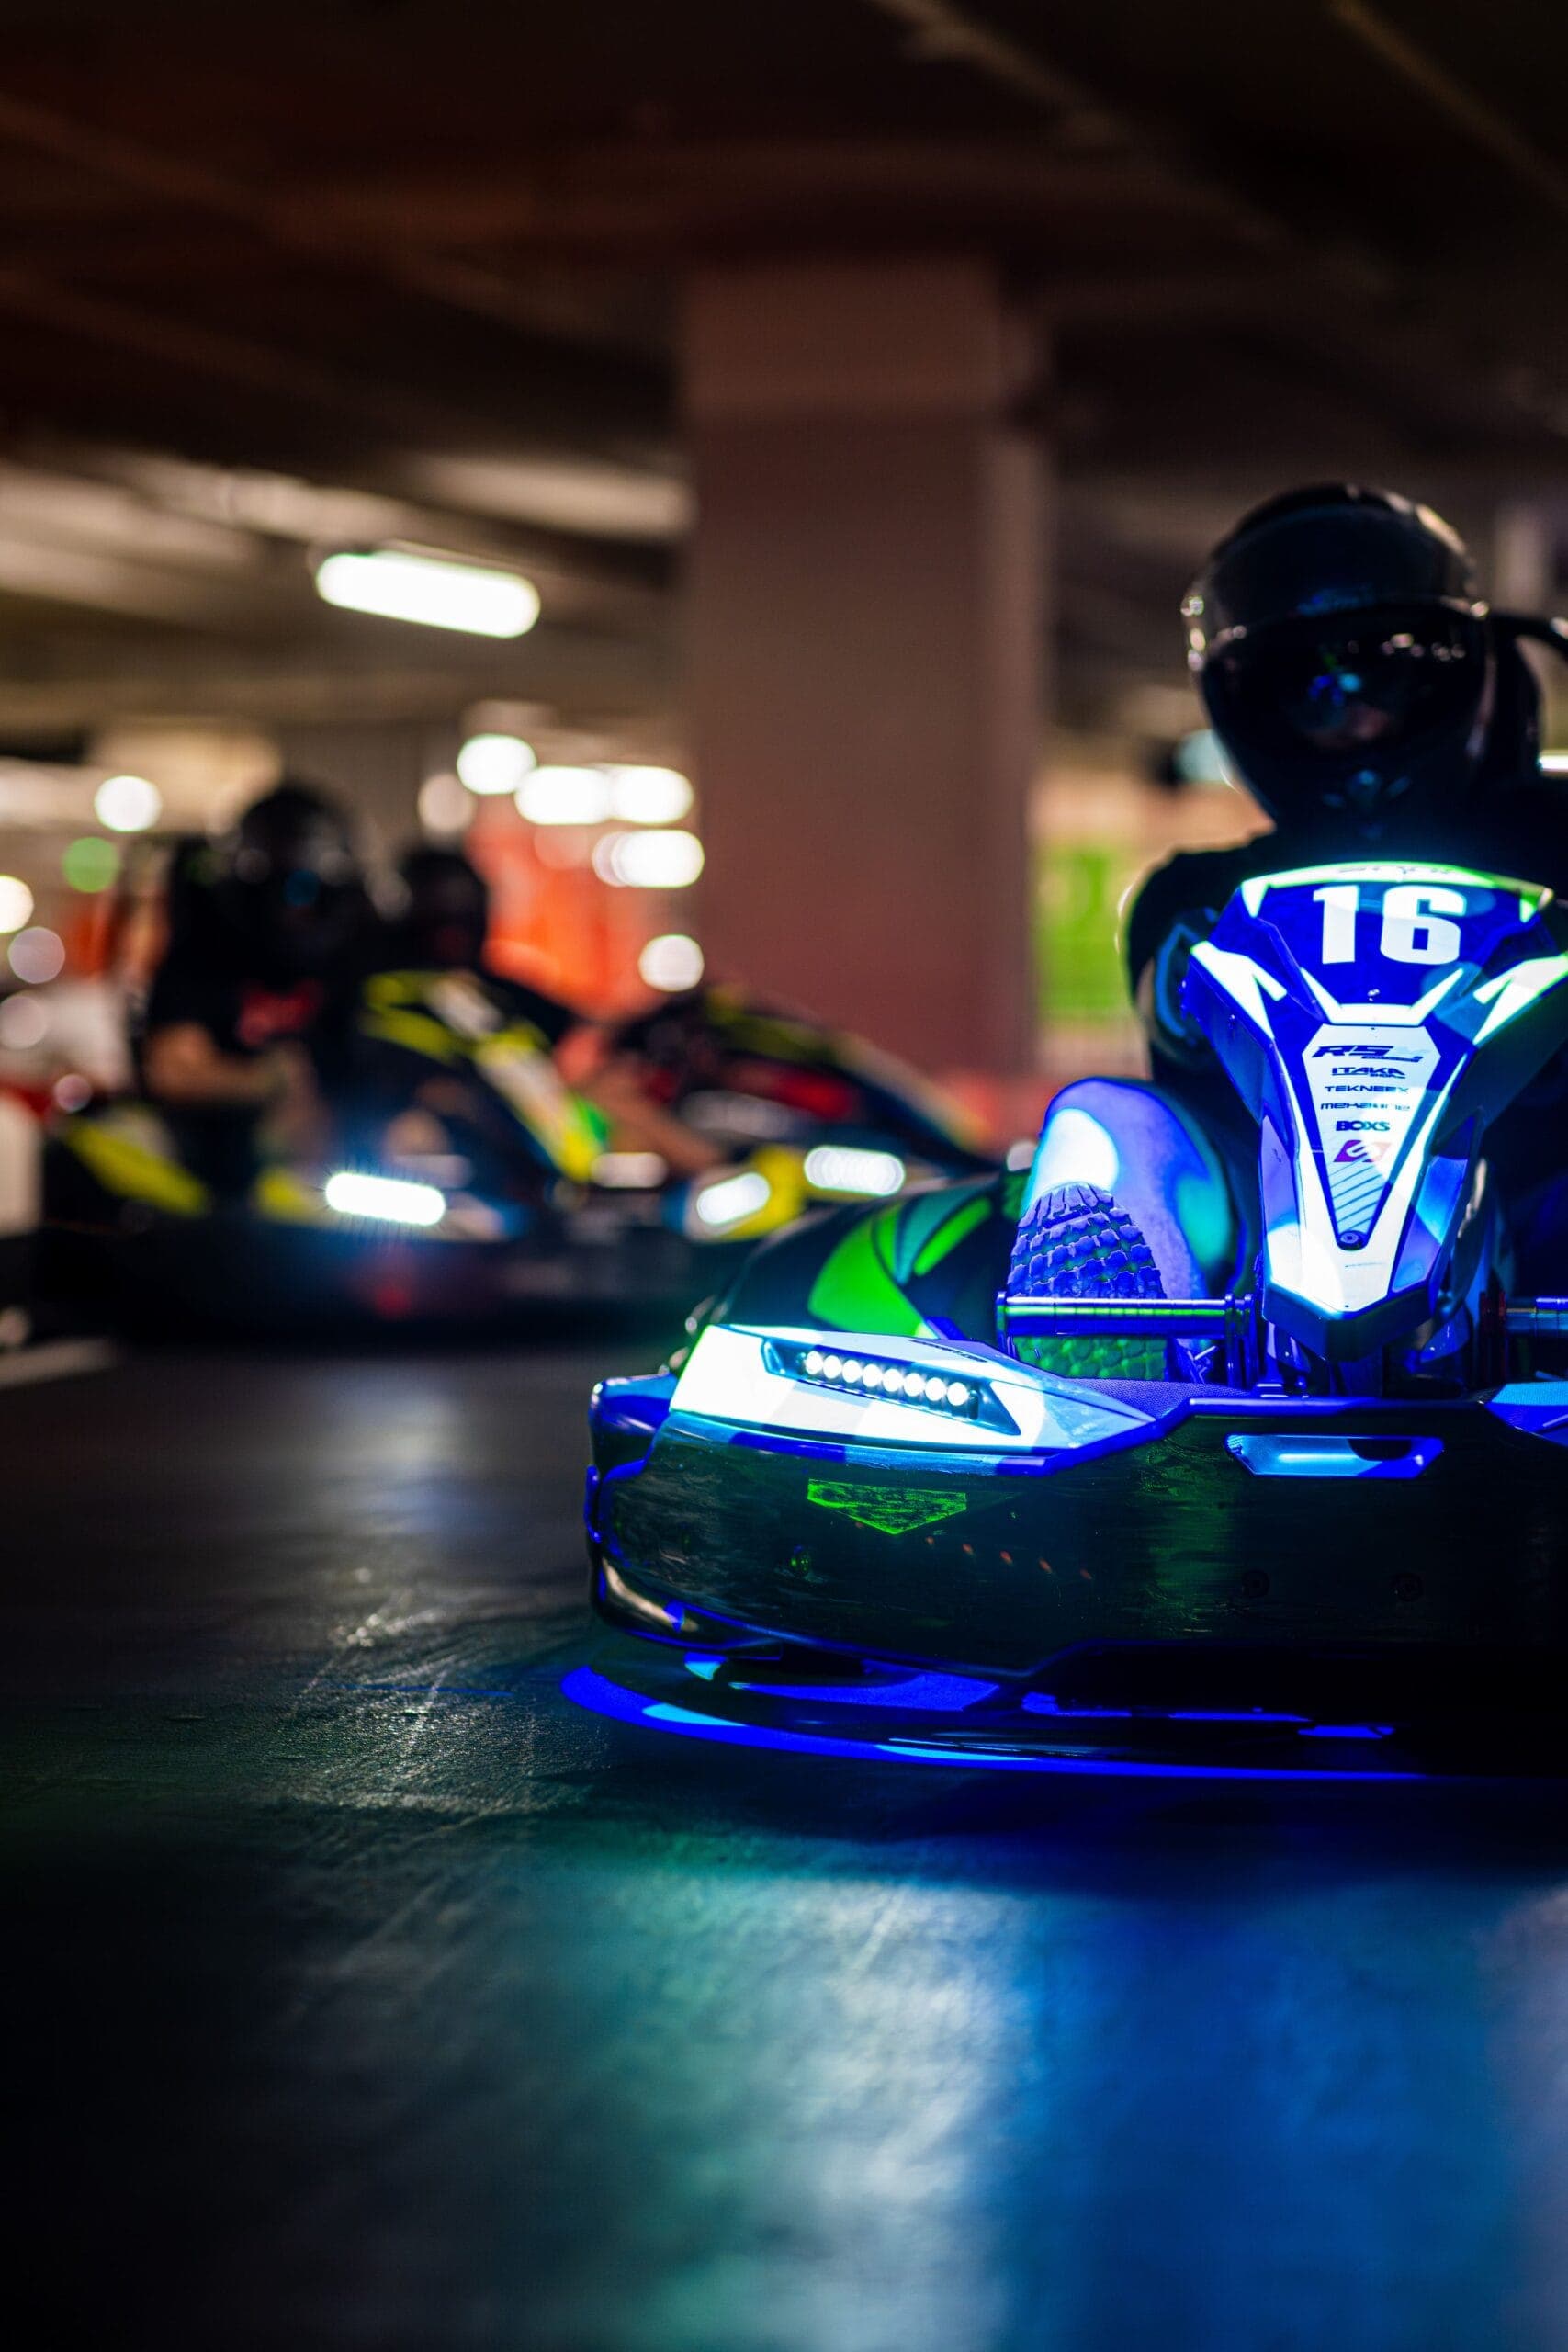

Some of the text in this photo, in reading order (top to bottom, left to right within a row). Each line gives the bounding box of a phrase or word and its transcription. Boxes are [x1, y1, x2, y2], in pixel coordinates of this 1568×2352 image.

[1314, 885, 1467, 966] 16
[1332, 1067, 1405, 1076] ITAKA
[1336, 1120, 1391, 1132] BOXS
